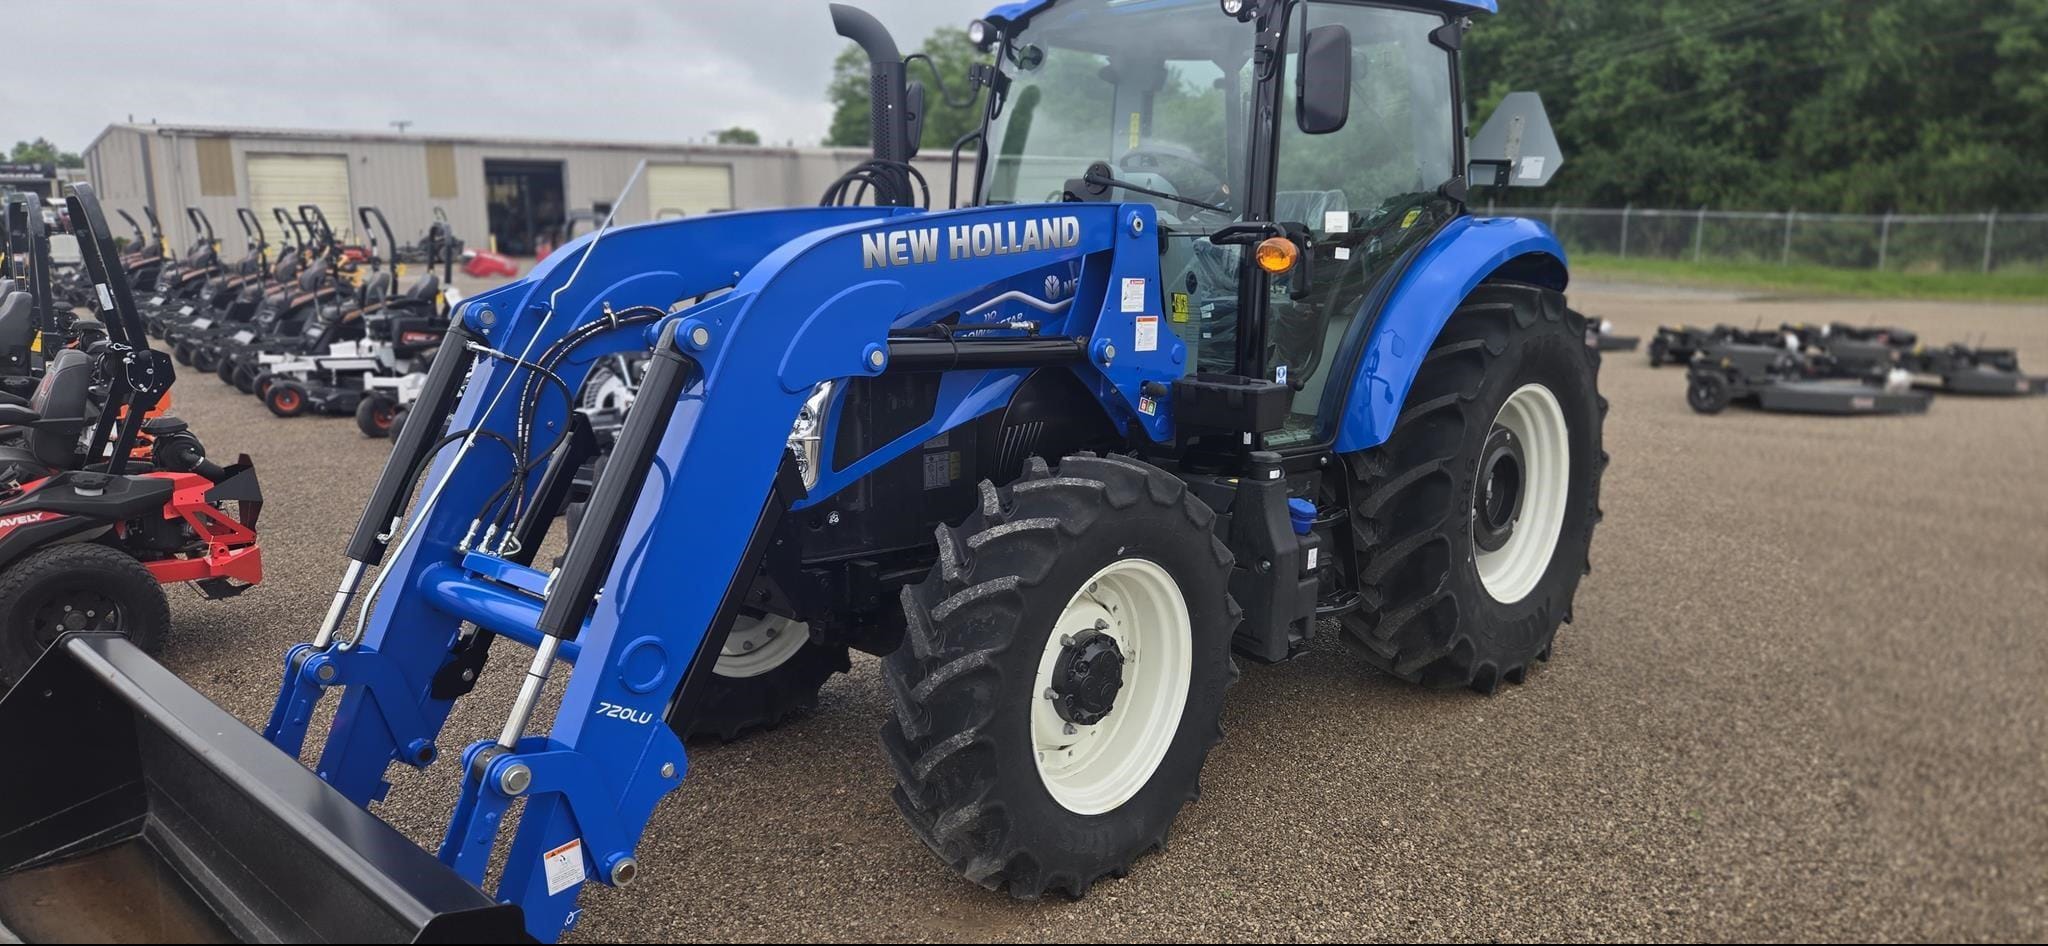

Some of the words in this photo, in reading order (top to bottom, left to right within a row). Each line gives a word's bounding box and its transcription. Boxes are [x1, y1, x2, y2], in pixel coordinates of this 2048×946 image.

[861, 227, 939, 269] NEW
[948, 215, 1080, 260] HOLLAND
[595, 701, 653, 724] 720LU
